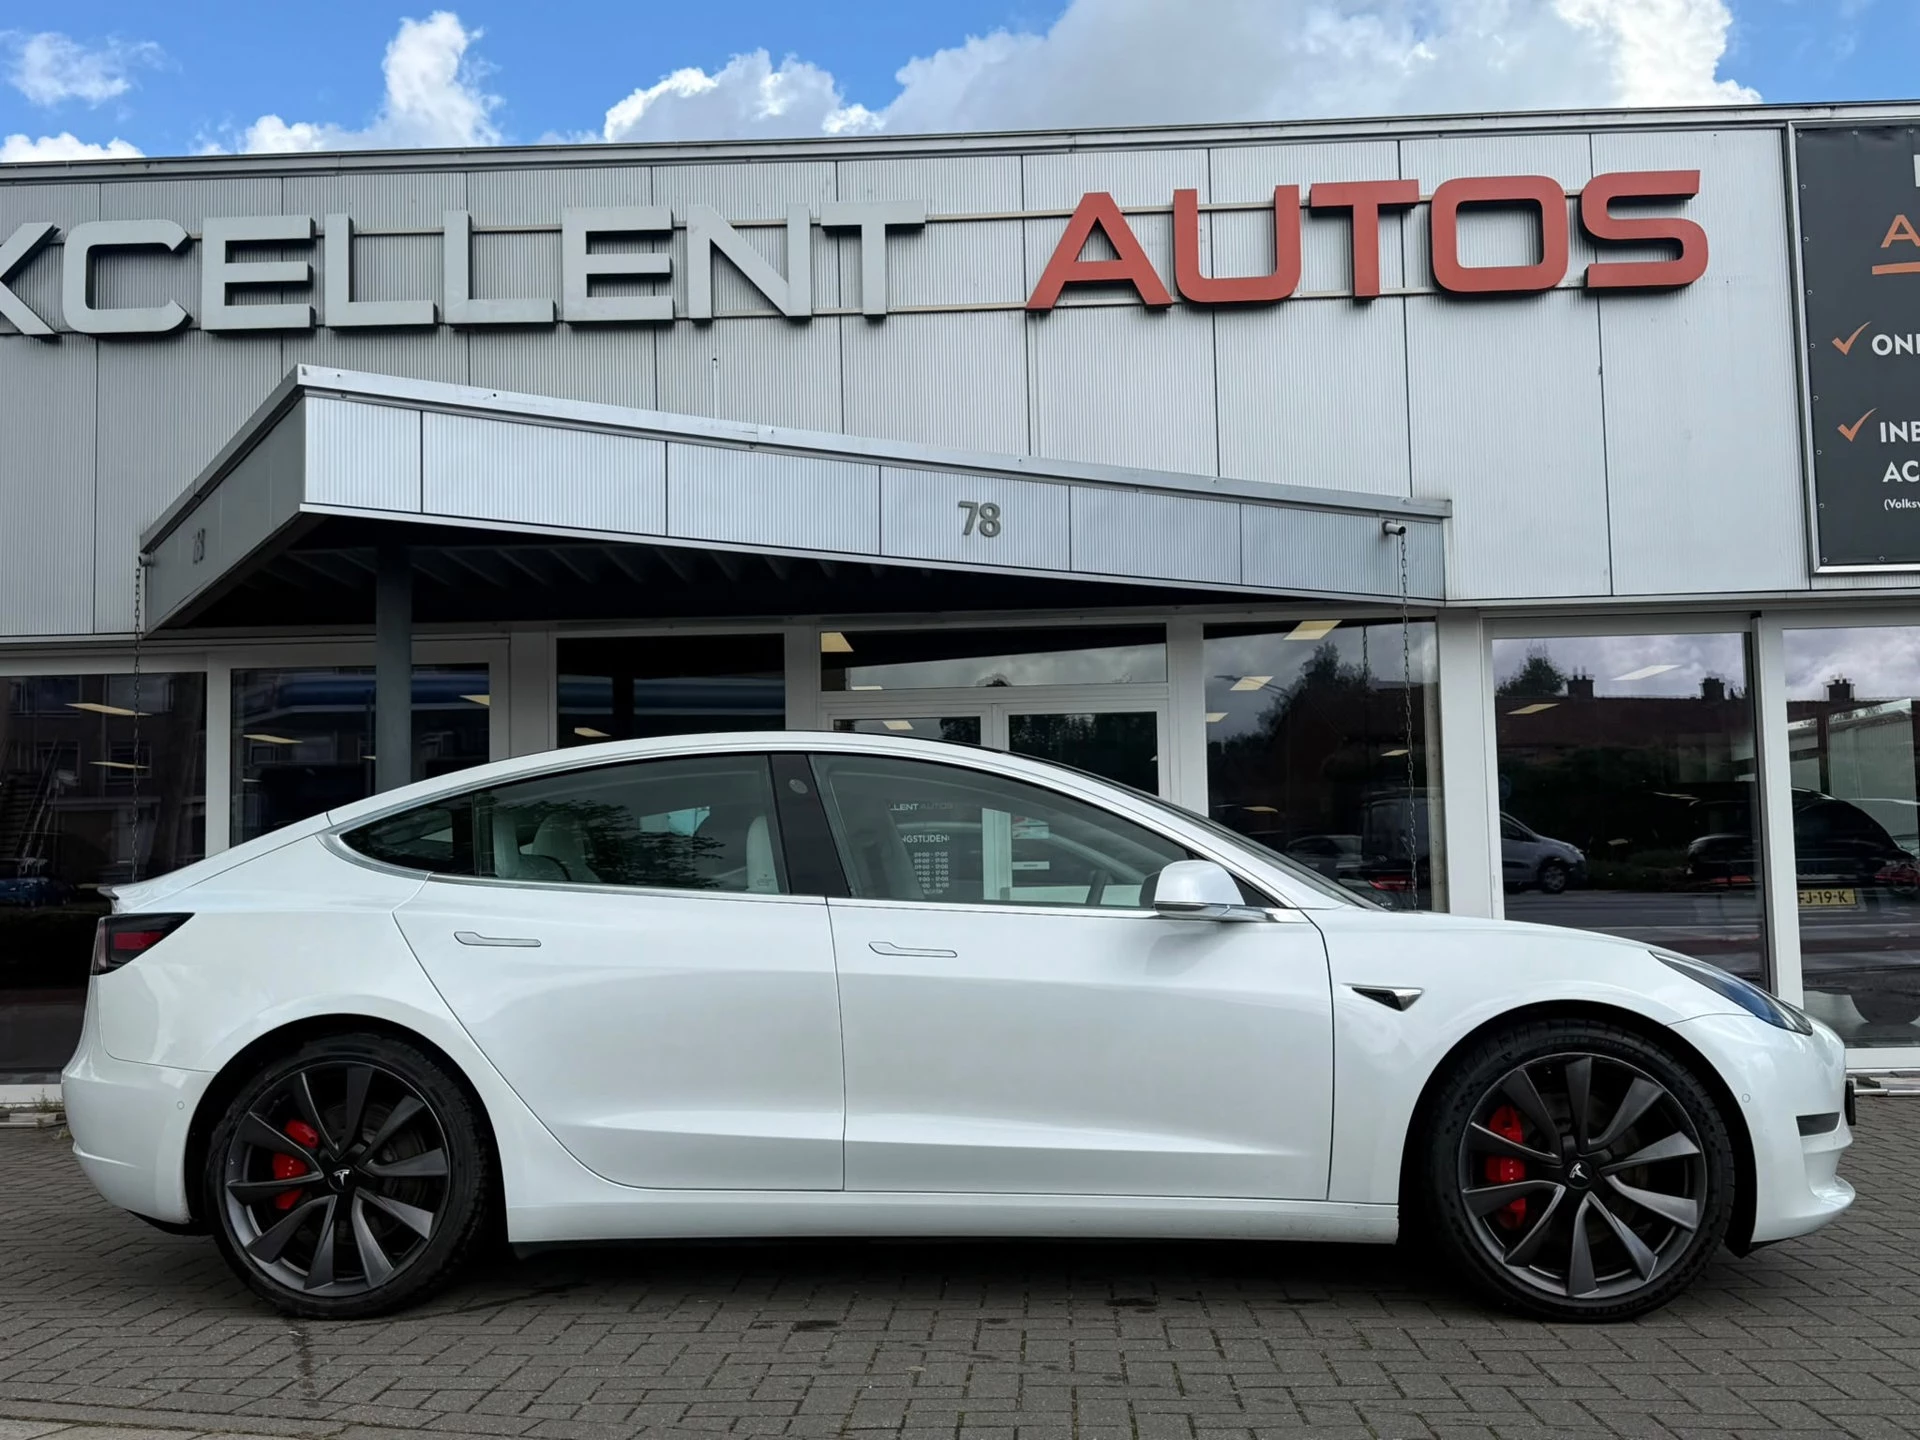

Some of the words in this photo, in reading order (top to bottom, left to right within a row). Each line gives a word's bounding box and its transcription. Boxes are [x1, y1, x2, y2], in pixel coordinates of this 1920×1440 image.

[1025, 169, 1709, 310] AUTOS
[1882, 460, 1920, 482] AC
[957, 500, 1001, 538] 78
